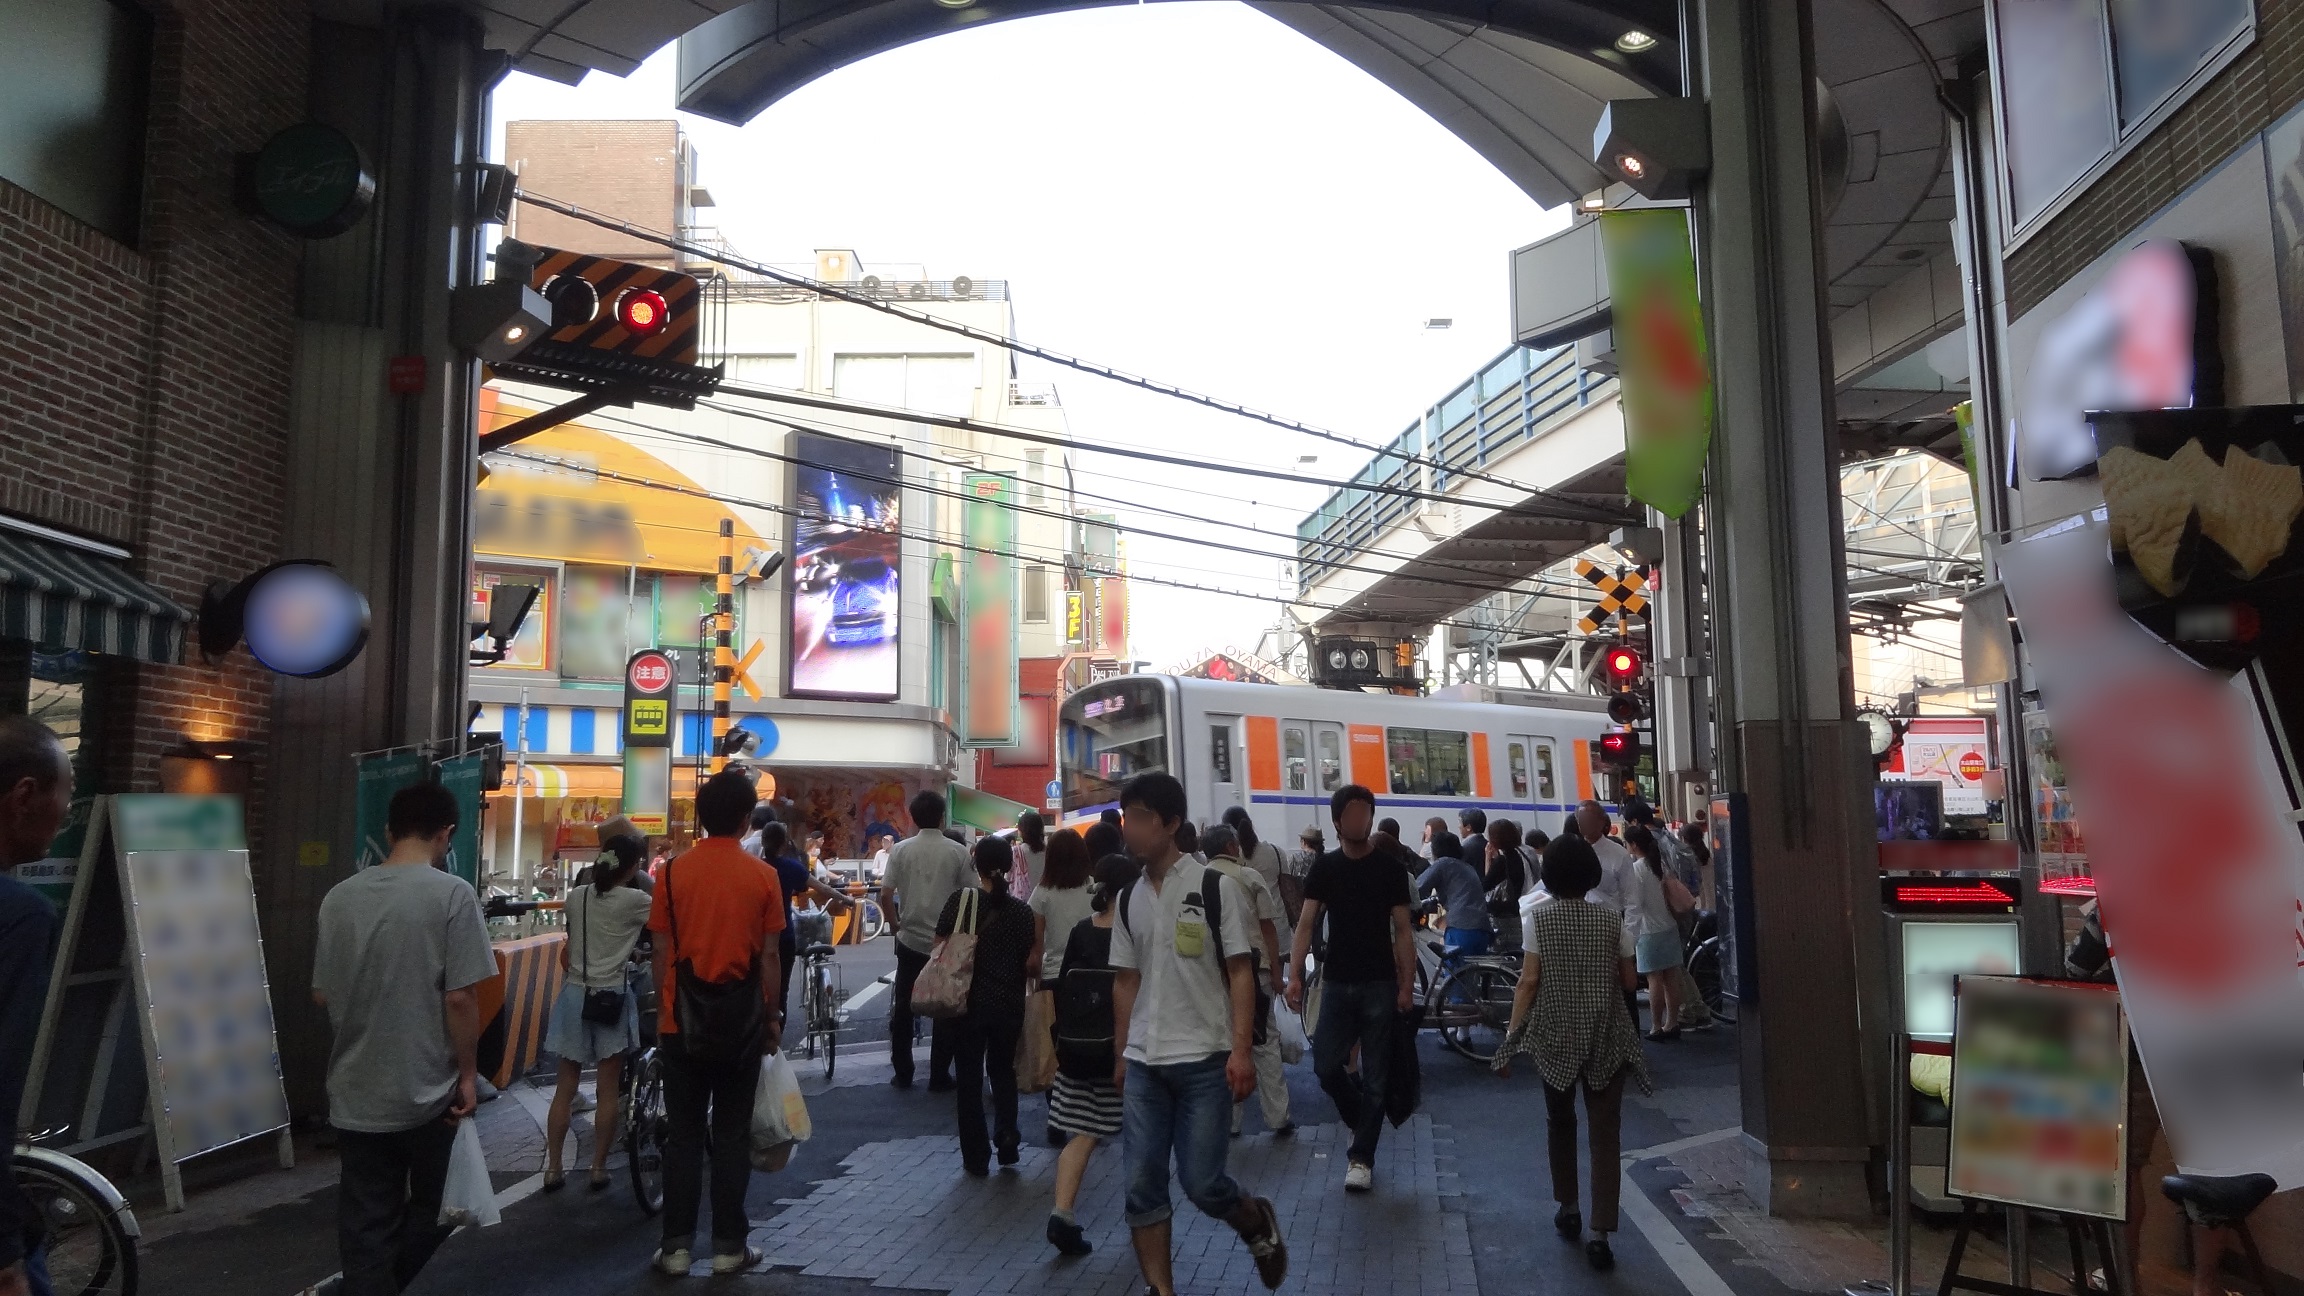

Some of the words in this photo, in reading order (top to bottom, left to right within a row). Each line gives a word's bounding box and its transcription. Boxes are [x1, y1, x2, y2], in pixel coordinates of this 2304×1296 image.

[976, 481, 1001, 496] 2F
[1068, 596, 1081, 638] 3F
[636, 666, 666, 680] 注意
[1195, 646, 1215, 663] ZA
[1225, 645, 1277, 679] OYAMA
